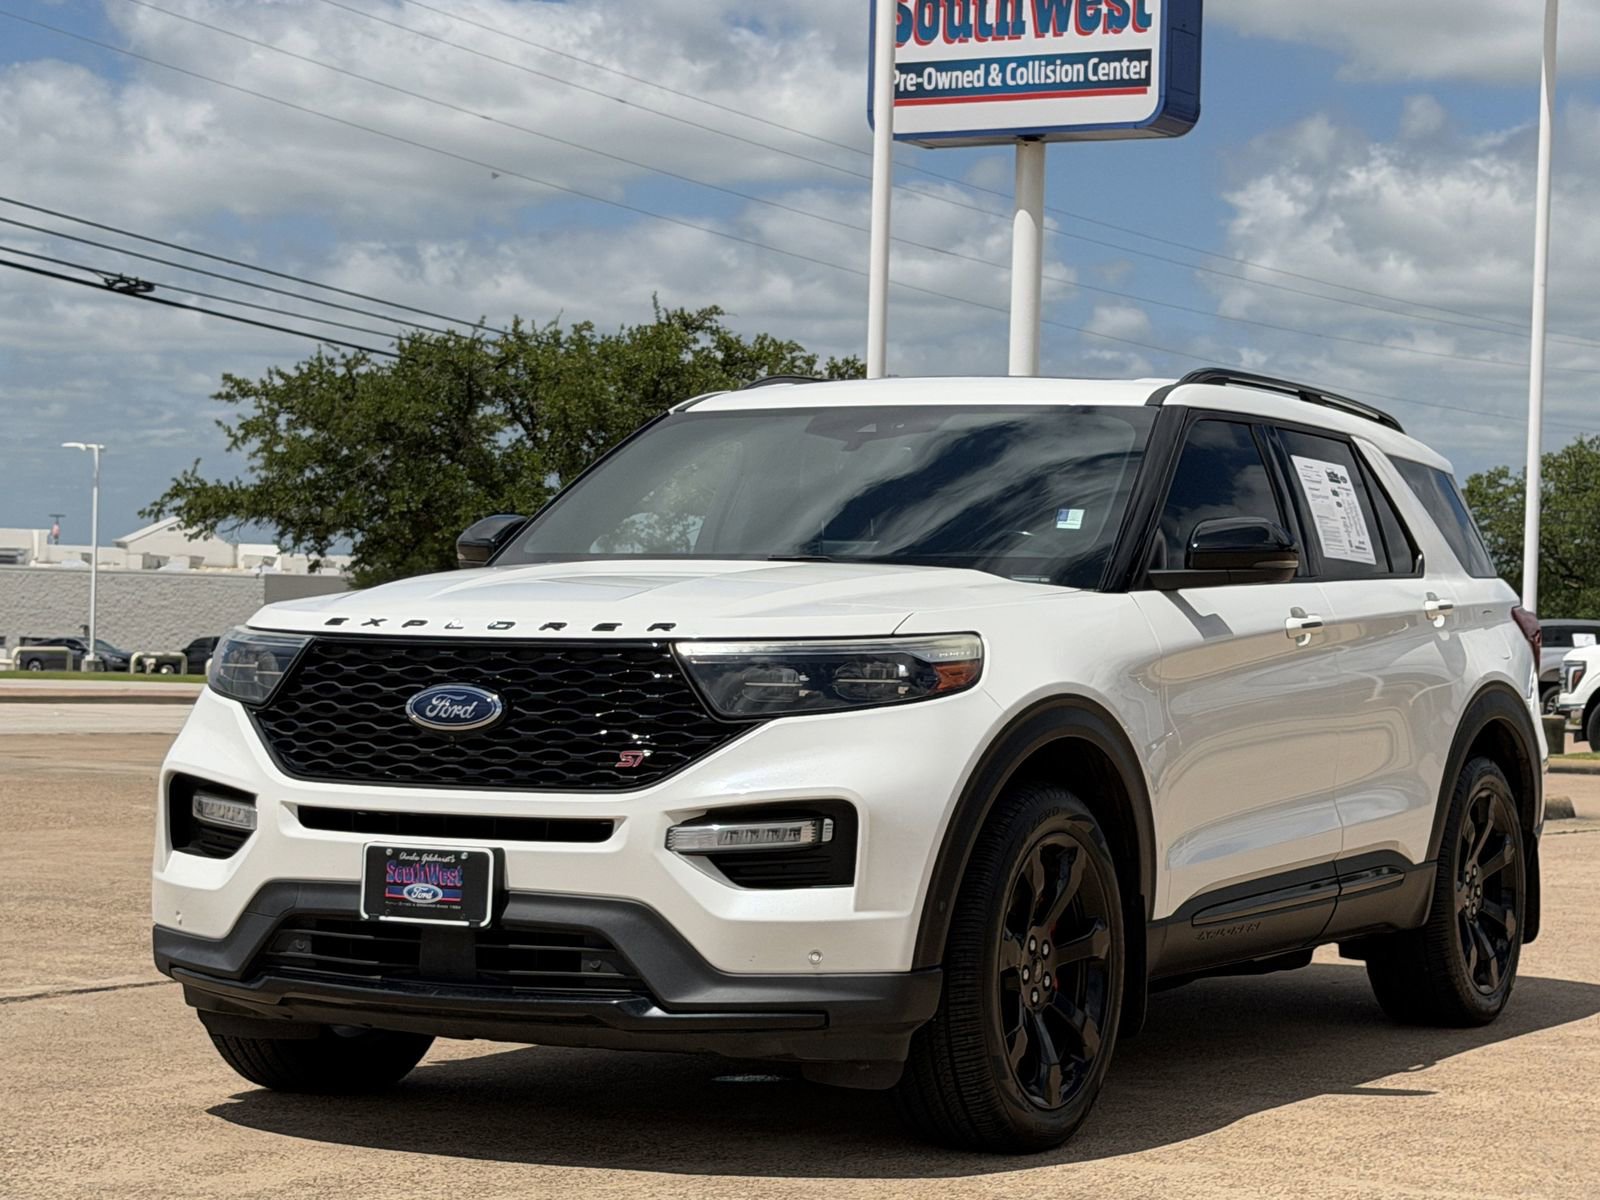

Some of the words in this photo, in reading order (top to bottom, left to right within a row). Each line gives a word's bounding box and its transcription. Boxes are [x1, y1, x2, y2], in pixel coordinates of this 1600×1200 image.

[894, 63, 985, 92] Pre-Owned
[987, 63, 1003, 87] &
[1006, 58, 1085, 86] Collision
[1087, 57, 1149, 82] Center
[324, 617, 677, 632] EXPLORER
[426, 694, 479, 720] Ford
[615, 749, 653, 767] ST
[386, 860, 463, 887] SouthWest
[411, 886, 434, 899] Ford
